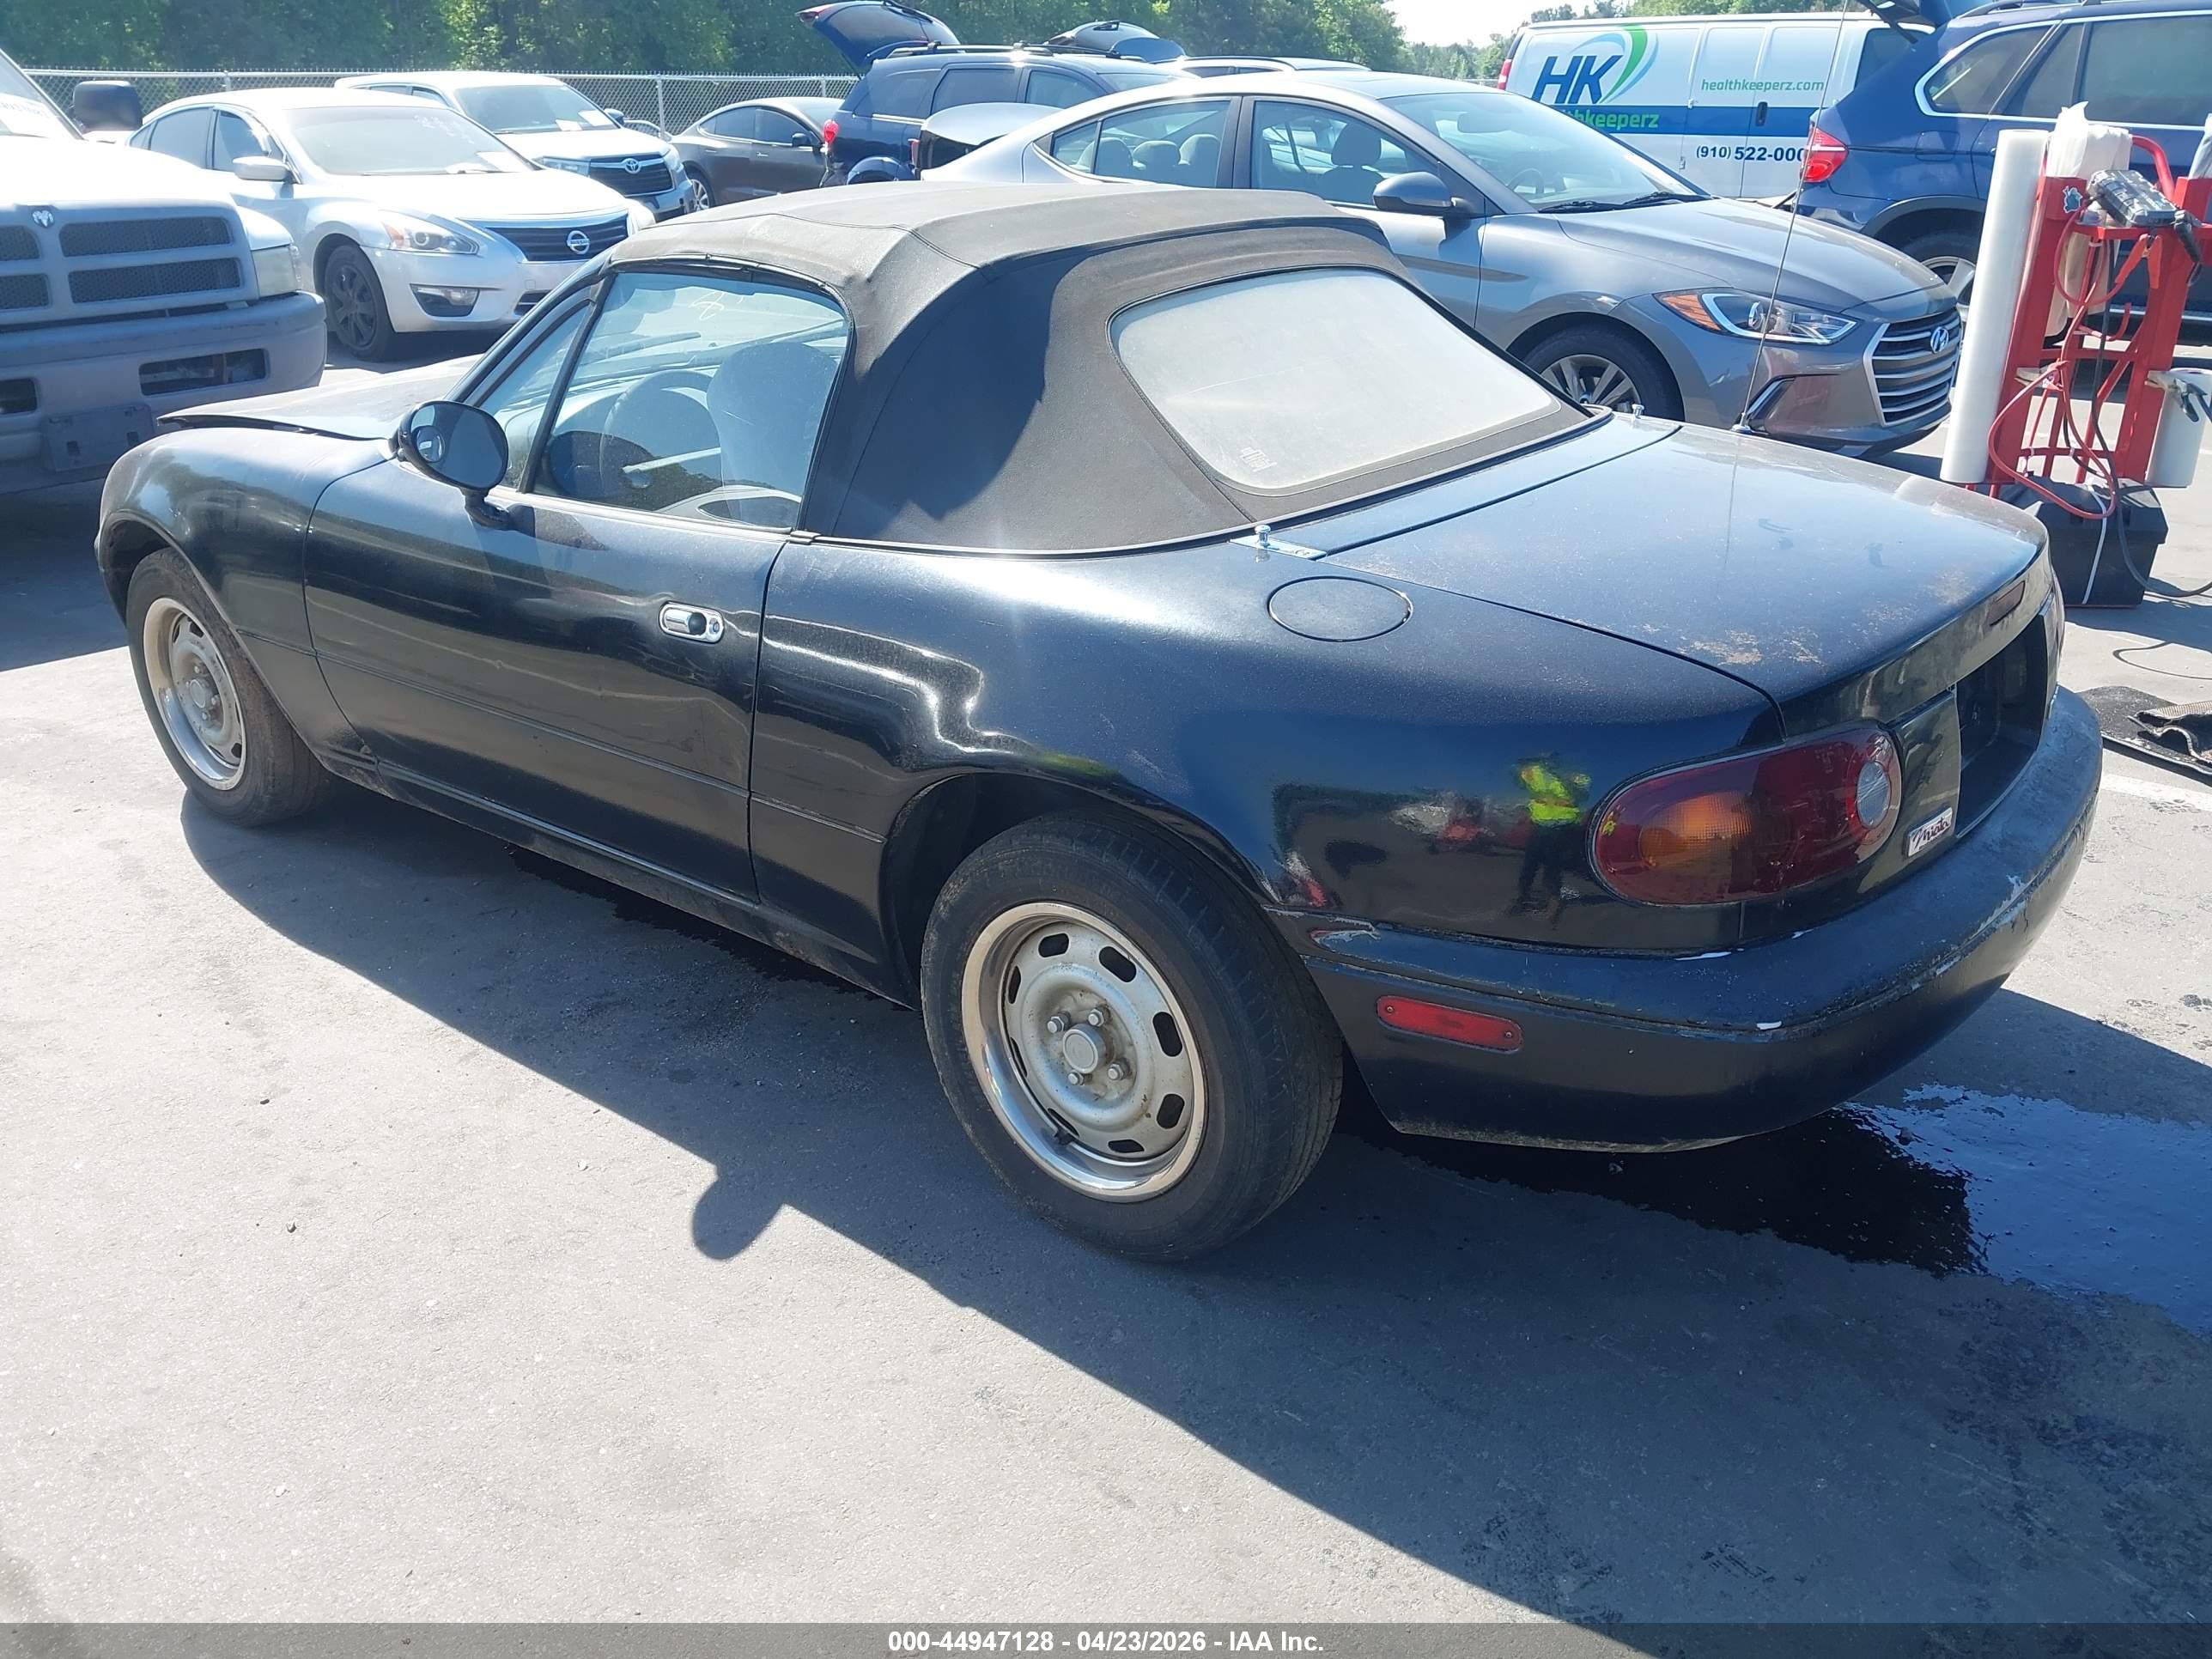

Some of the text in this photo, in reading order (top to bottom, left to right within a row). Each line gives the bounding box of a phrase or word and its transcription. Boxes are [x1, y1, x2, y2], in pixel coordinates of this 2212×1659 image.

[1531, 55, 1623, 104] HK
[1701, 79, 1825, 92] healthkeeperz.com
[1696, 146, 1731, 159] (910)
[1912, 817, 1949, 849] Miata
